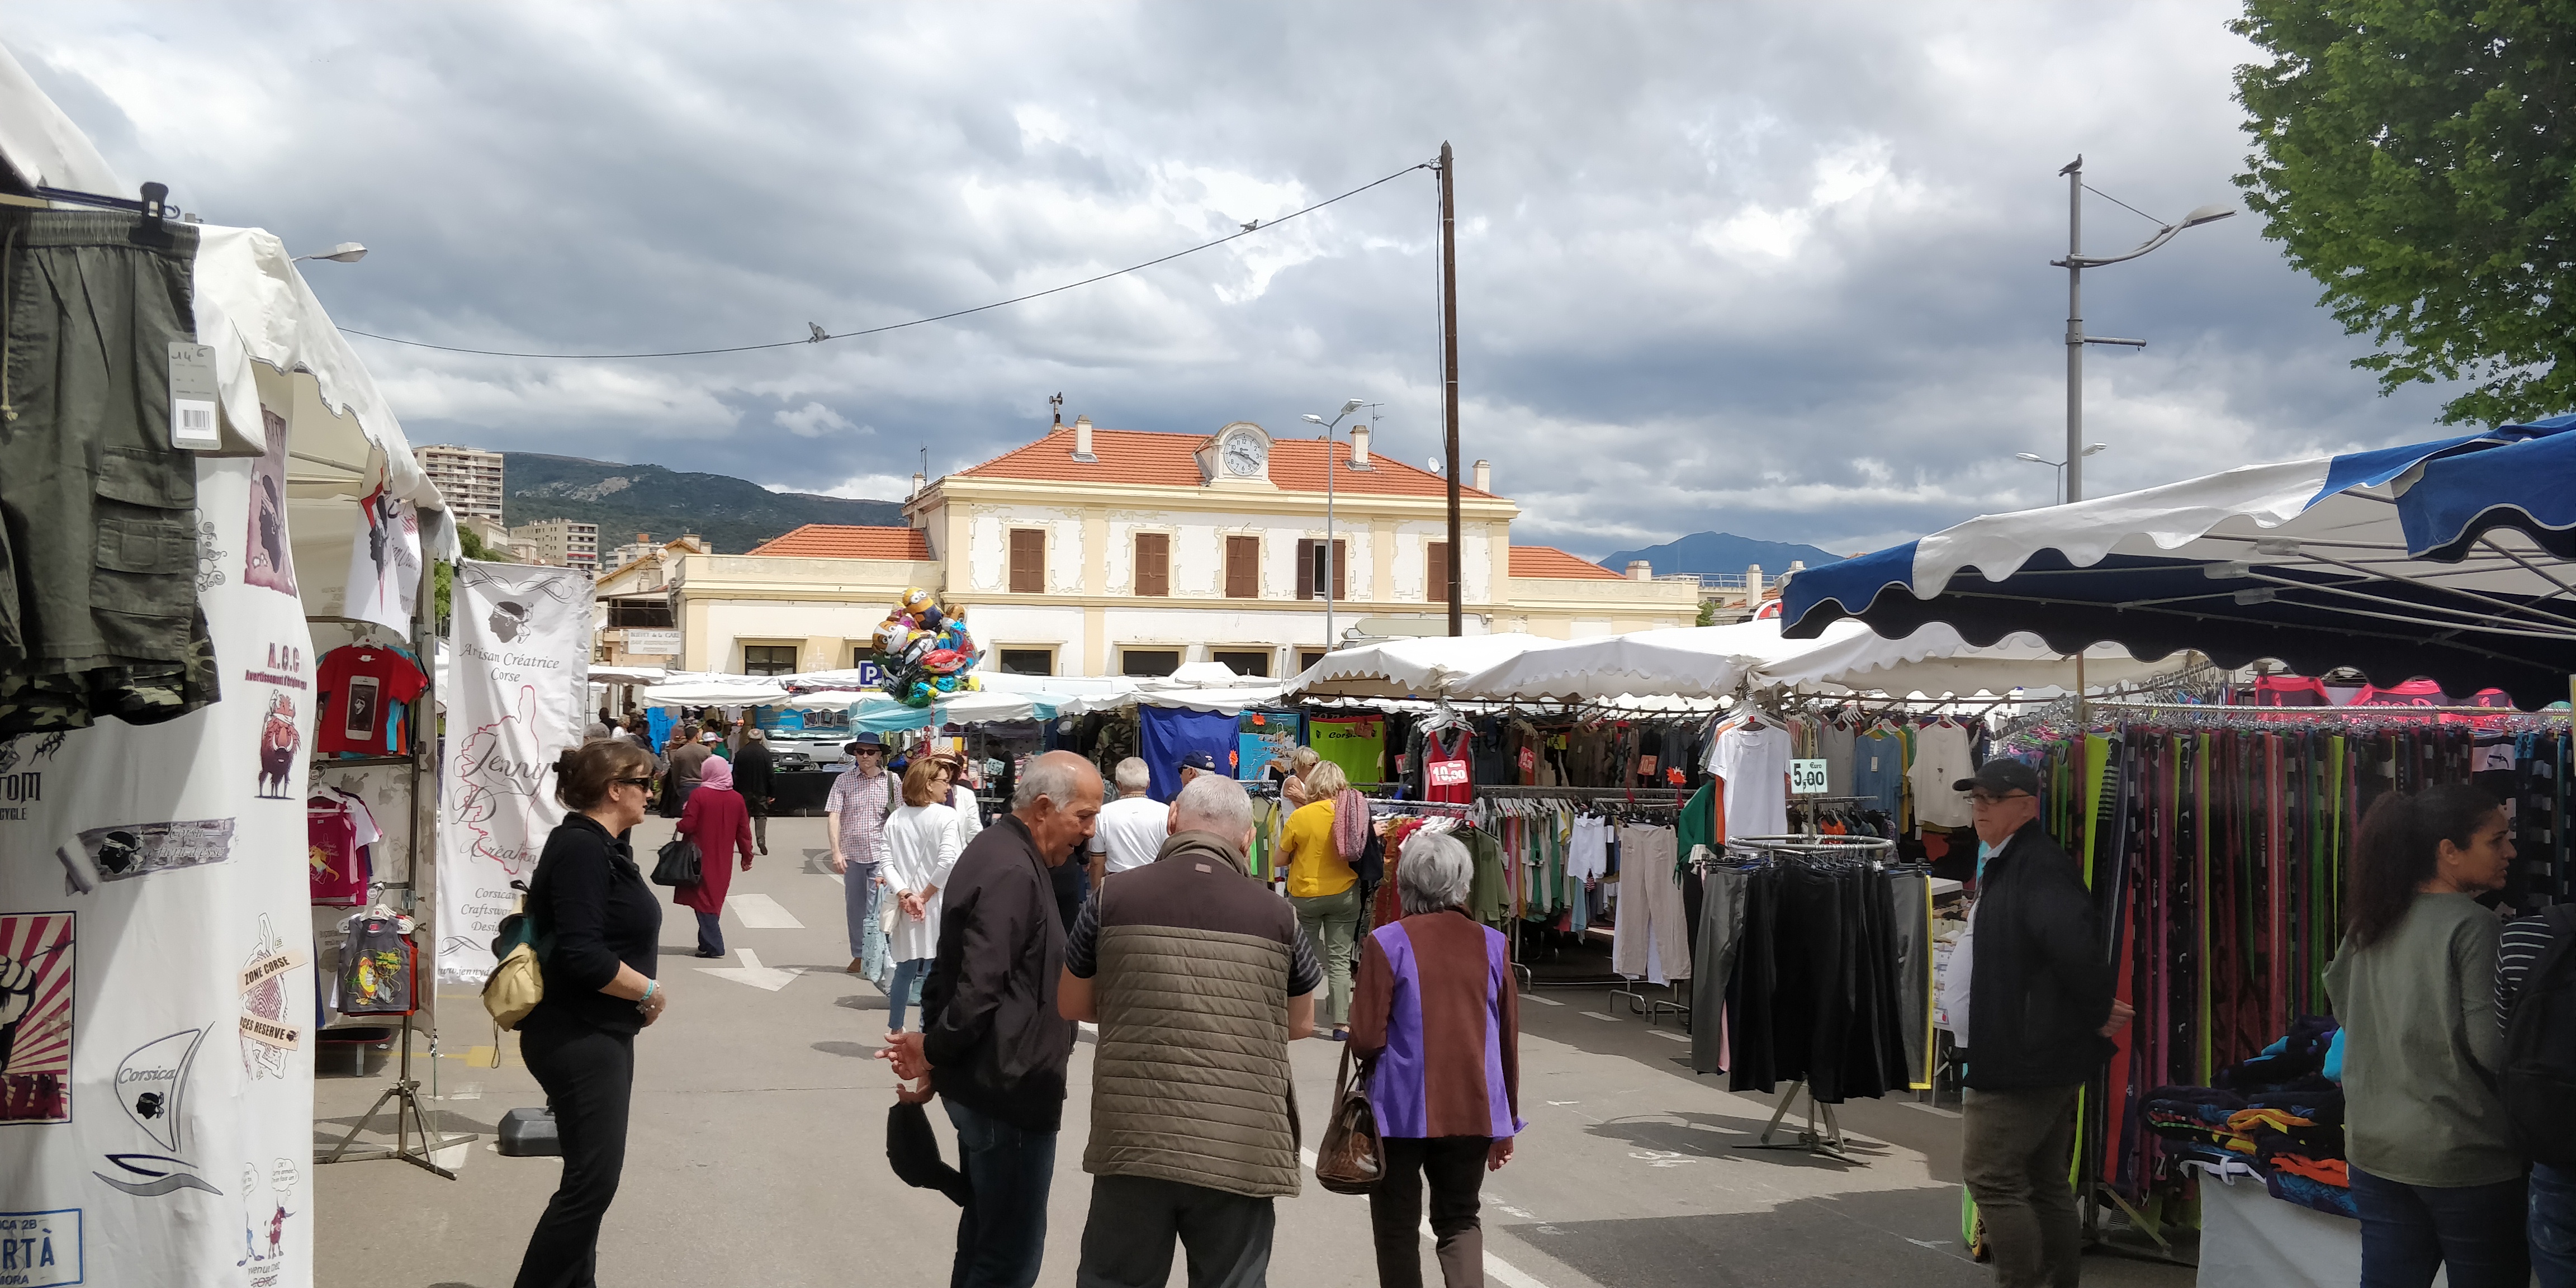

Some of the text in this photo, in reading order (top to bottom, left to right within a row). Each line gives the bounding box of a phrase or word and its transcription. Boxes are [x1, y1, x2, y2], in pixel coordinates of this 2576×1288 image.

[504, 653, 560, 669] Créatrice
[491, 667, 520, 682] Corse
[865, 666, 878, 681] P
[1793, 763, 1824, 790] 5,00
[471, 921, 501, 936] Desig
[244, 956, 290, 986] ZONE CORSE
[254, 1020, 286, 1040] RESERVE
[118, 1066, 174, 1085] Corsica
[22, 1219, 37, 1230] 2B
